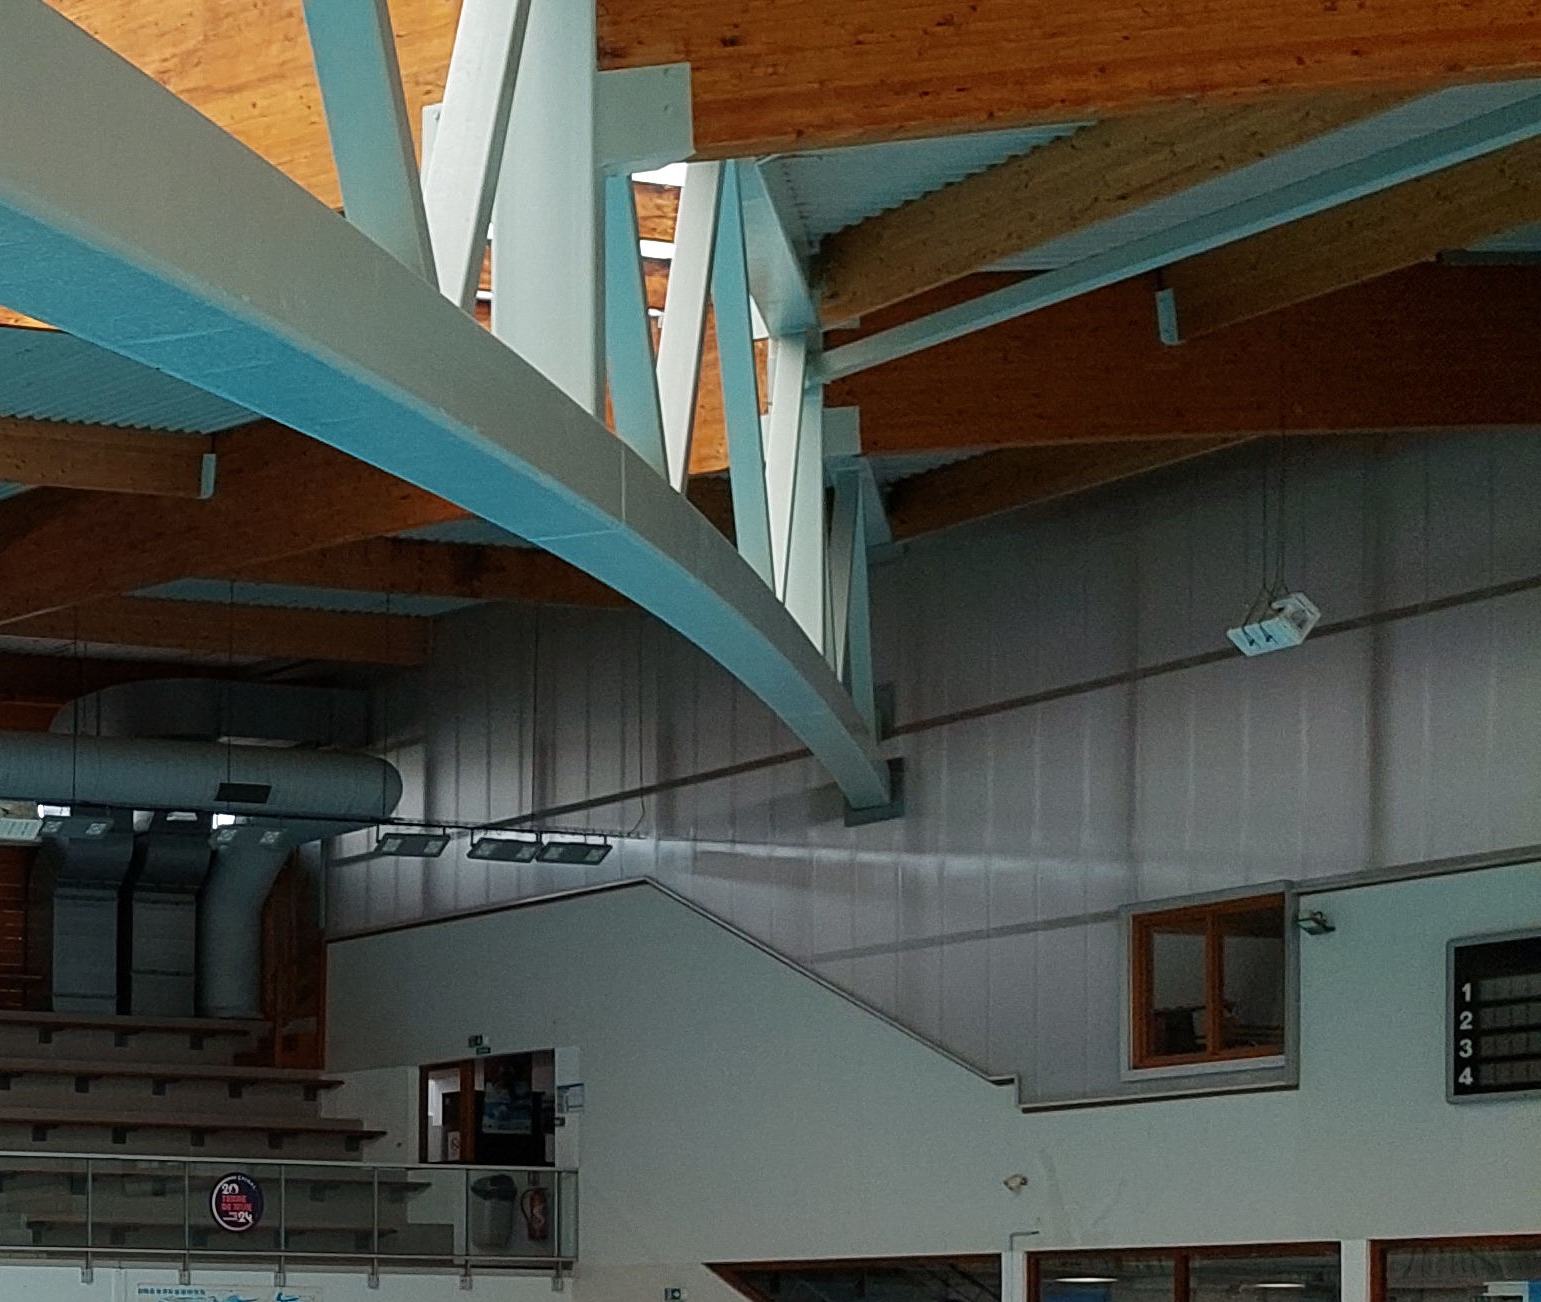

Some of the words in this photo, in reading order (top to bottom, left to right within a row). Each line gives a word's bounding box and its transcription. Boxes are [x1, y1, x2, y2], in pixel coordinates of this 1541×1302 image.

[1462, 983, 1471, 1002] 1
[1459, 1011, 1473, 1030] 2
[1459, 1039, 1473, 1058] 3
[1458, 1067, 1473, 1086] 4
[221, 1183, 239, 1194] 20
[238, 1211, 253, 1222] 24
